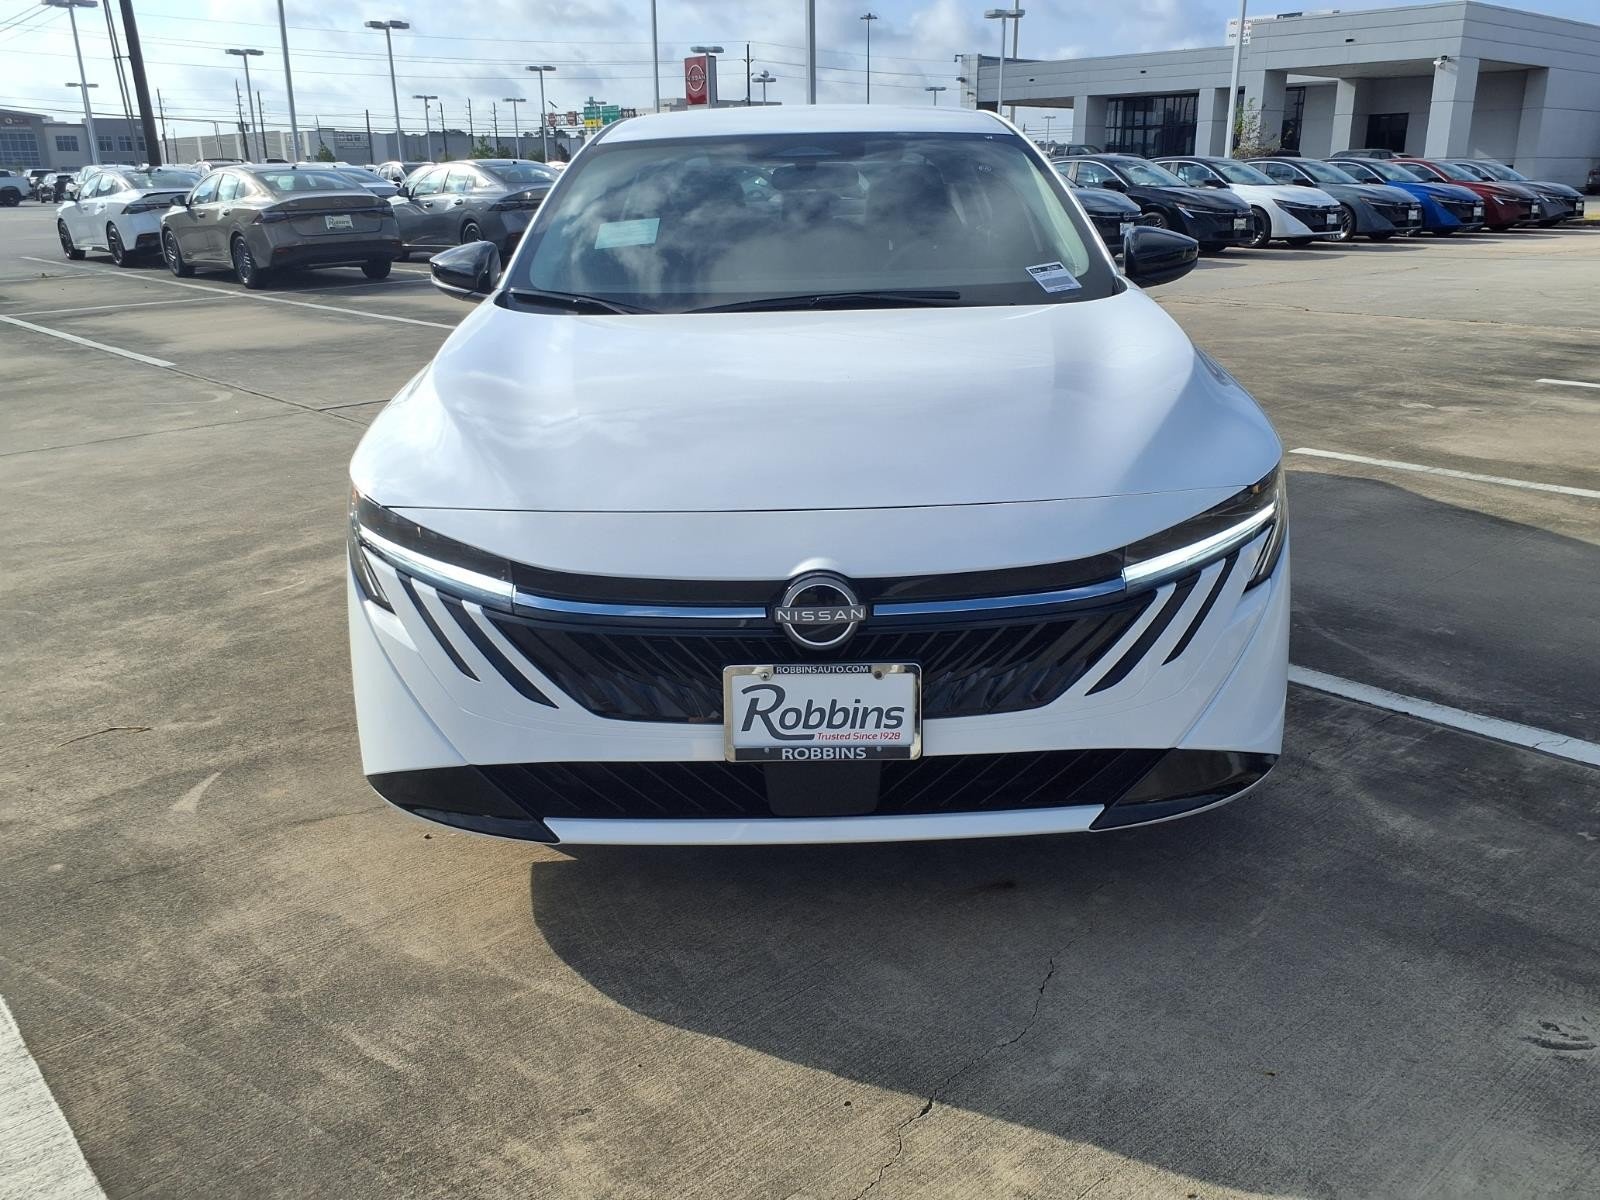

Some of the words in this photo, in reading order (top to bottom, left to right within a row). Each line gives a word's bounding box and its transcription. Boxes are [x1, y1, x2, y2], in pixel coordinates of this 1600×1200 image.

[777, 608, 864, 621] NISSAN
[776, 665, 869, 674] ROBBINSAUTO.COM
[741, 683, 905, 741] Robbins
[817, 732, 851, 740] Trusted
[853, 732, 878, 740] Since
[880, 732, 901, 740] 1928
[781, 747, 867, 760] ROBBINS
